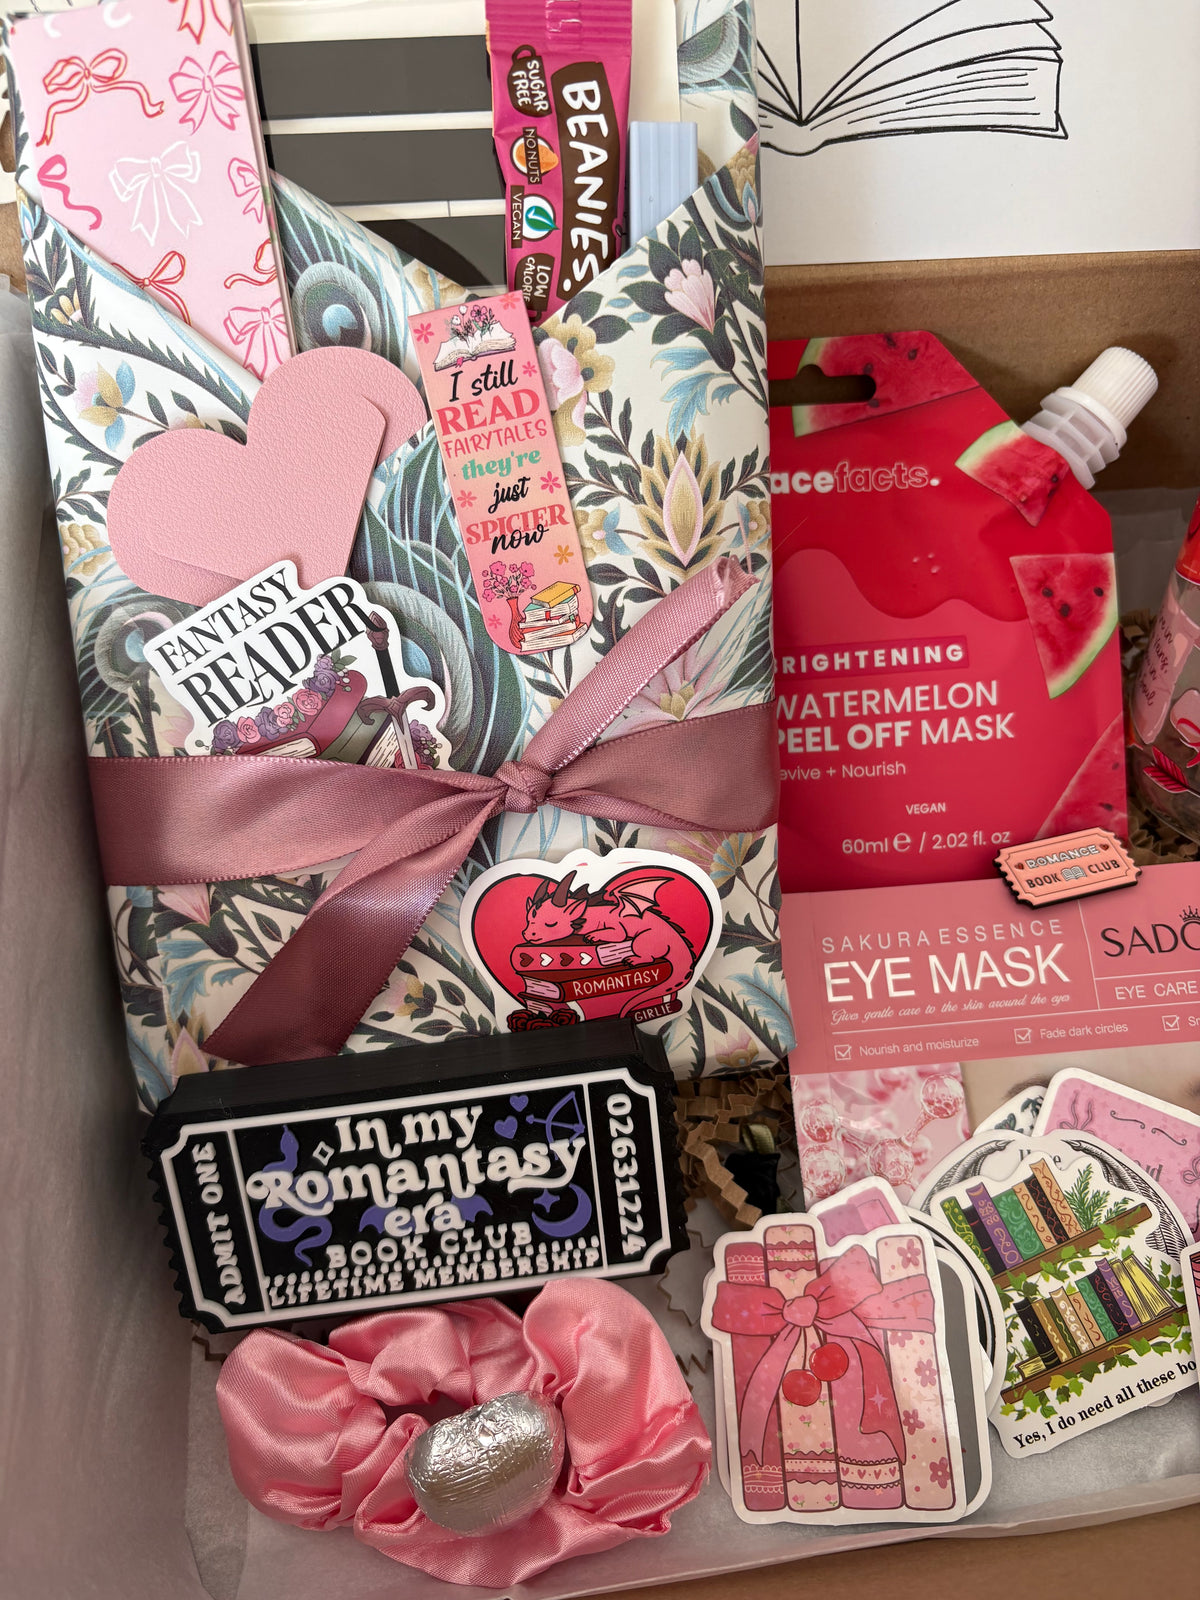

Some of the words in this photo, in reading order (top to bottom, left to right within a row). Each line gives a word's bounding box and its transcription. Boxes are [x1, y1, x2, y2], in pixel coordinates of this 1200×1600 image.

[512, 70, 531, 107] FREE
[527, 60, 549, 112] SUGAR
[525, 128, 536, 149] NO
[527, 151, 540, 184] NUTS
[562, 80, 609, 292] BEANIES.
[512, 192, 521, 241] VEGAN
[534, 265, 552, 298] LOW
[449, 370, 463, 403] I
[471, 359, 519, 397] still
[435, 388, 541, 437] READ
[442, 419, 548, 460] FAIRYTALES
[461, 449, 542, 482] they're
[770, 461, 940, 494] acefacts.
[488, 476, 531, 515] just
[466, 503, 570, 545] SPICIER
[491, 524, 550, 555] now
[154, 567, 297, 675] FANTASY
[177, 583, 388, 728] READER
[776, 680, 998, 721] WATERMELON
[847, 720, 912, 750] OFF
[921, 712, 1015, 746] MASK
[780, 765, 821, 781] evive
[842, 760, 907, 779] Nourish
[905, 802, 947, 815] VEGAN
[842, 837, 888, 854] 60ml
[932, 832, 968, 850] 2.02
[972, 830, 986, 847] fl.
[991, 831, 1011, 844] oz
[1025, 844, 1101, 870] ROMANCE
[1026, 872, 1062, 889] BOOK
[1088, 859, 1121, 875] CLUB
[822, 930, 931, 954] SAKURA
[939, 919, 1063, 945] ESSENCE
[572, 969, 660, 997] ROMANTASY
[824, 956, 915, 1003] EYE
[928, 942, 1071, 994] MASK
[1115, 985, 1146, 1000] EYE
[1153, 981, 1199, 997] CARE
[634, 1003, 672, 1022] GIRLIE
[830, 1008, 859, 1026] Gives
[862, 1006, 894, 1024] gentle
[898, 1007, 921, 1016] care
[925, 1004, 936, 1015] to
[941, 1001, 958, 1014] the
[961, 999, 984, 1012] skin
[988, 994, 1027, 1009] around
[1030, 992, 1047, 1005] the
[1051, 993, 1070, 1007] eyes
[859, 1043, 900, 1058] Nourish
[903, 1040, 924, 1053] and
[926, 1036, 979, 1051] moisturize
[1040, 1026, 1066, 1040] Fade
[1069, 1023, 1093, 1037] dark
[1095, 1021, 1128, 1036] circles
[334, 1117, 402, 1159] In
[401, 1105, 483, 1149] my
[192, 1141, 224, 1205] ONE
[246, 1137, 586, 1216] Romantasy
[606, 1093, 647, 1256] 02631224
[384, 1192, 466, 1237] era
[206, 1210, 247, 1305] ADMIT
[325, 1233, 427, 1269] BOOK
[440, 1221, 532, 1255] CLUB
[269, 1271, 404, 1307] LIFETIME
[414, 1246, 601, 1290] MEMBERSHIP
[1013, 1429, 1047, 1449] Yes,
[1045, 1420, 1056, 1436] I
[1057, 1414, 1076, 1431] do
[1078, 1395, 1114, 1421] need
[1115, 1385, 1136, 1405] all
[1136, 1369, 1177, 1396] these
